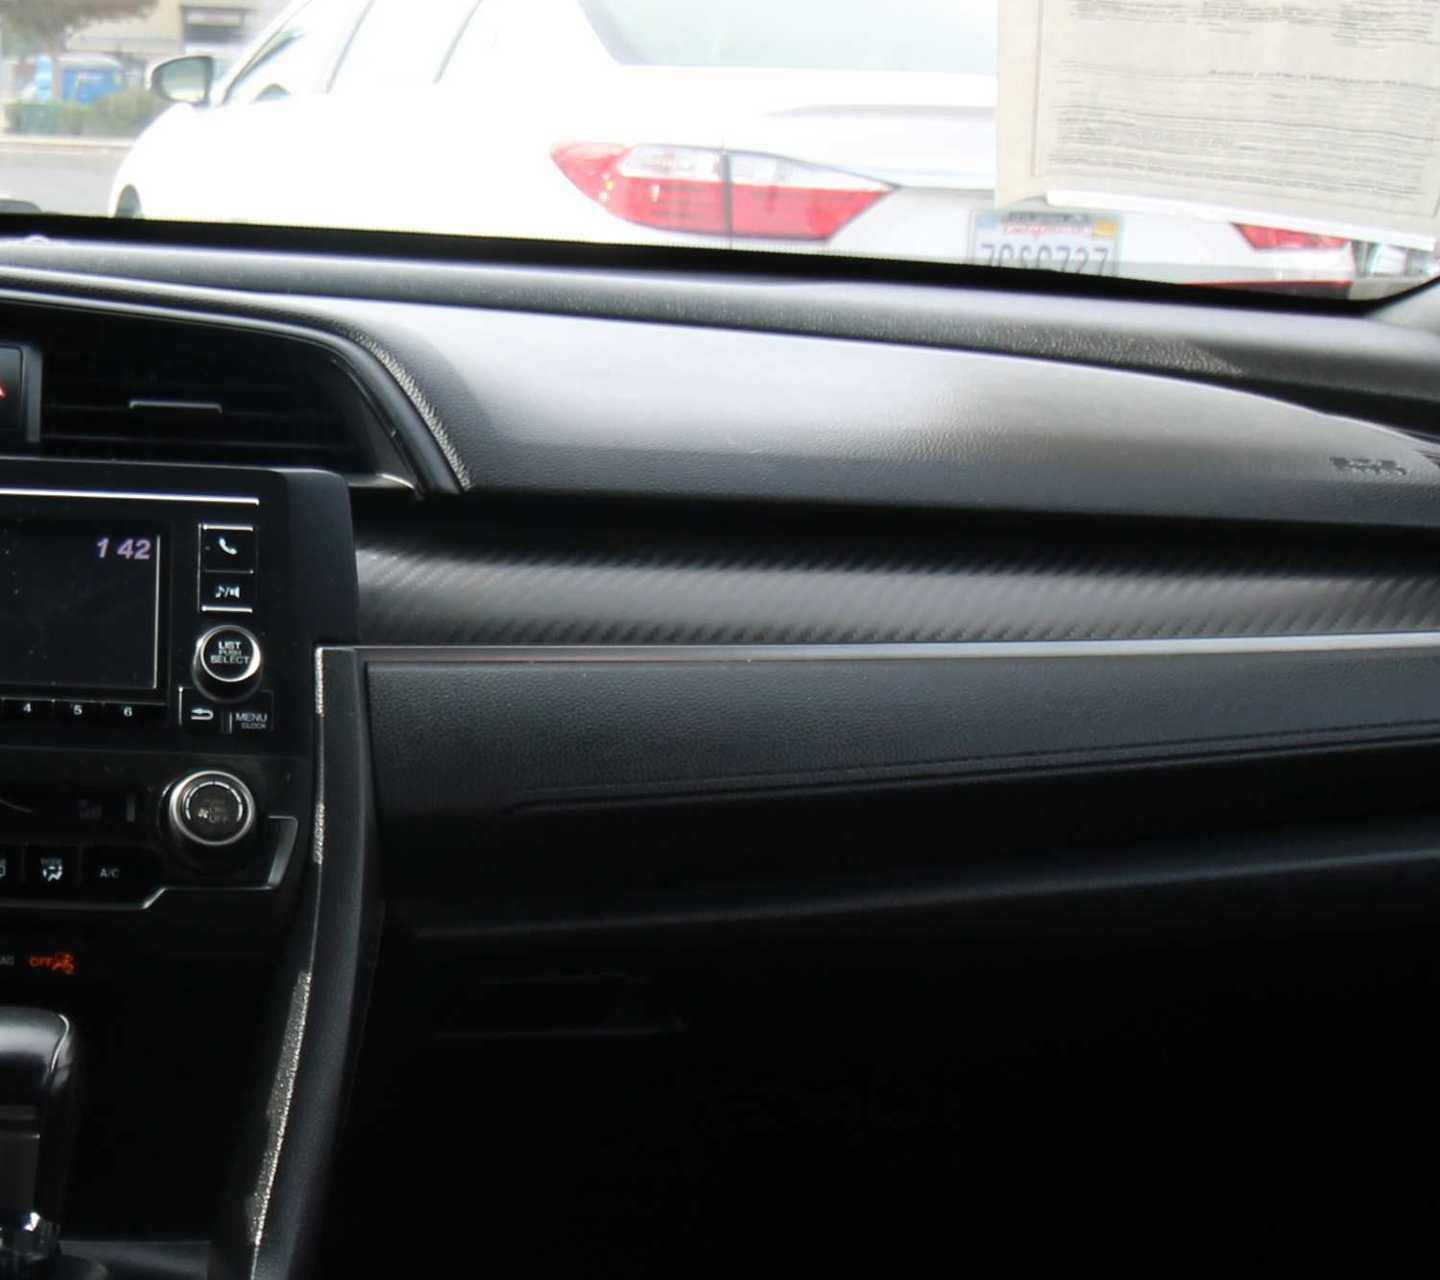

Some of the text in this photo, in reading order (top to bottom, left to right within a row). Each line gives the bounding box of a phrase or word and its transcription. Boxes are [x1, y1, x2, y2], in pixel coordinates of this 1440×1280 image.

[218, 640, 242, 650] LIST
[210, 654, 250, 664] SELECT
[22, 702, 32, 713] 4
[72, 704, 83, 715] 5
[122, 706, 133, 717] 6
[235, 712, 268, 723] MENU
